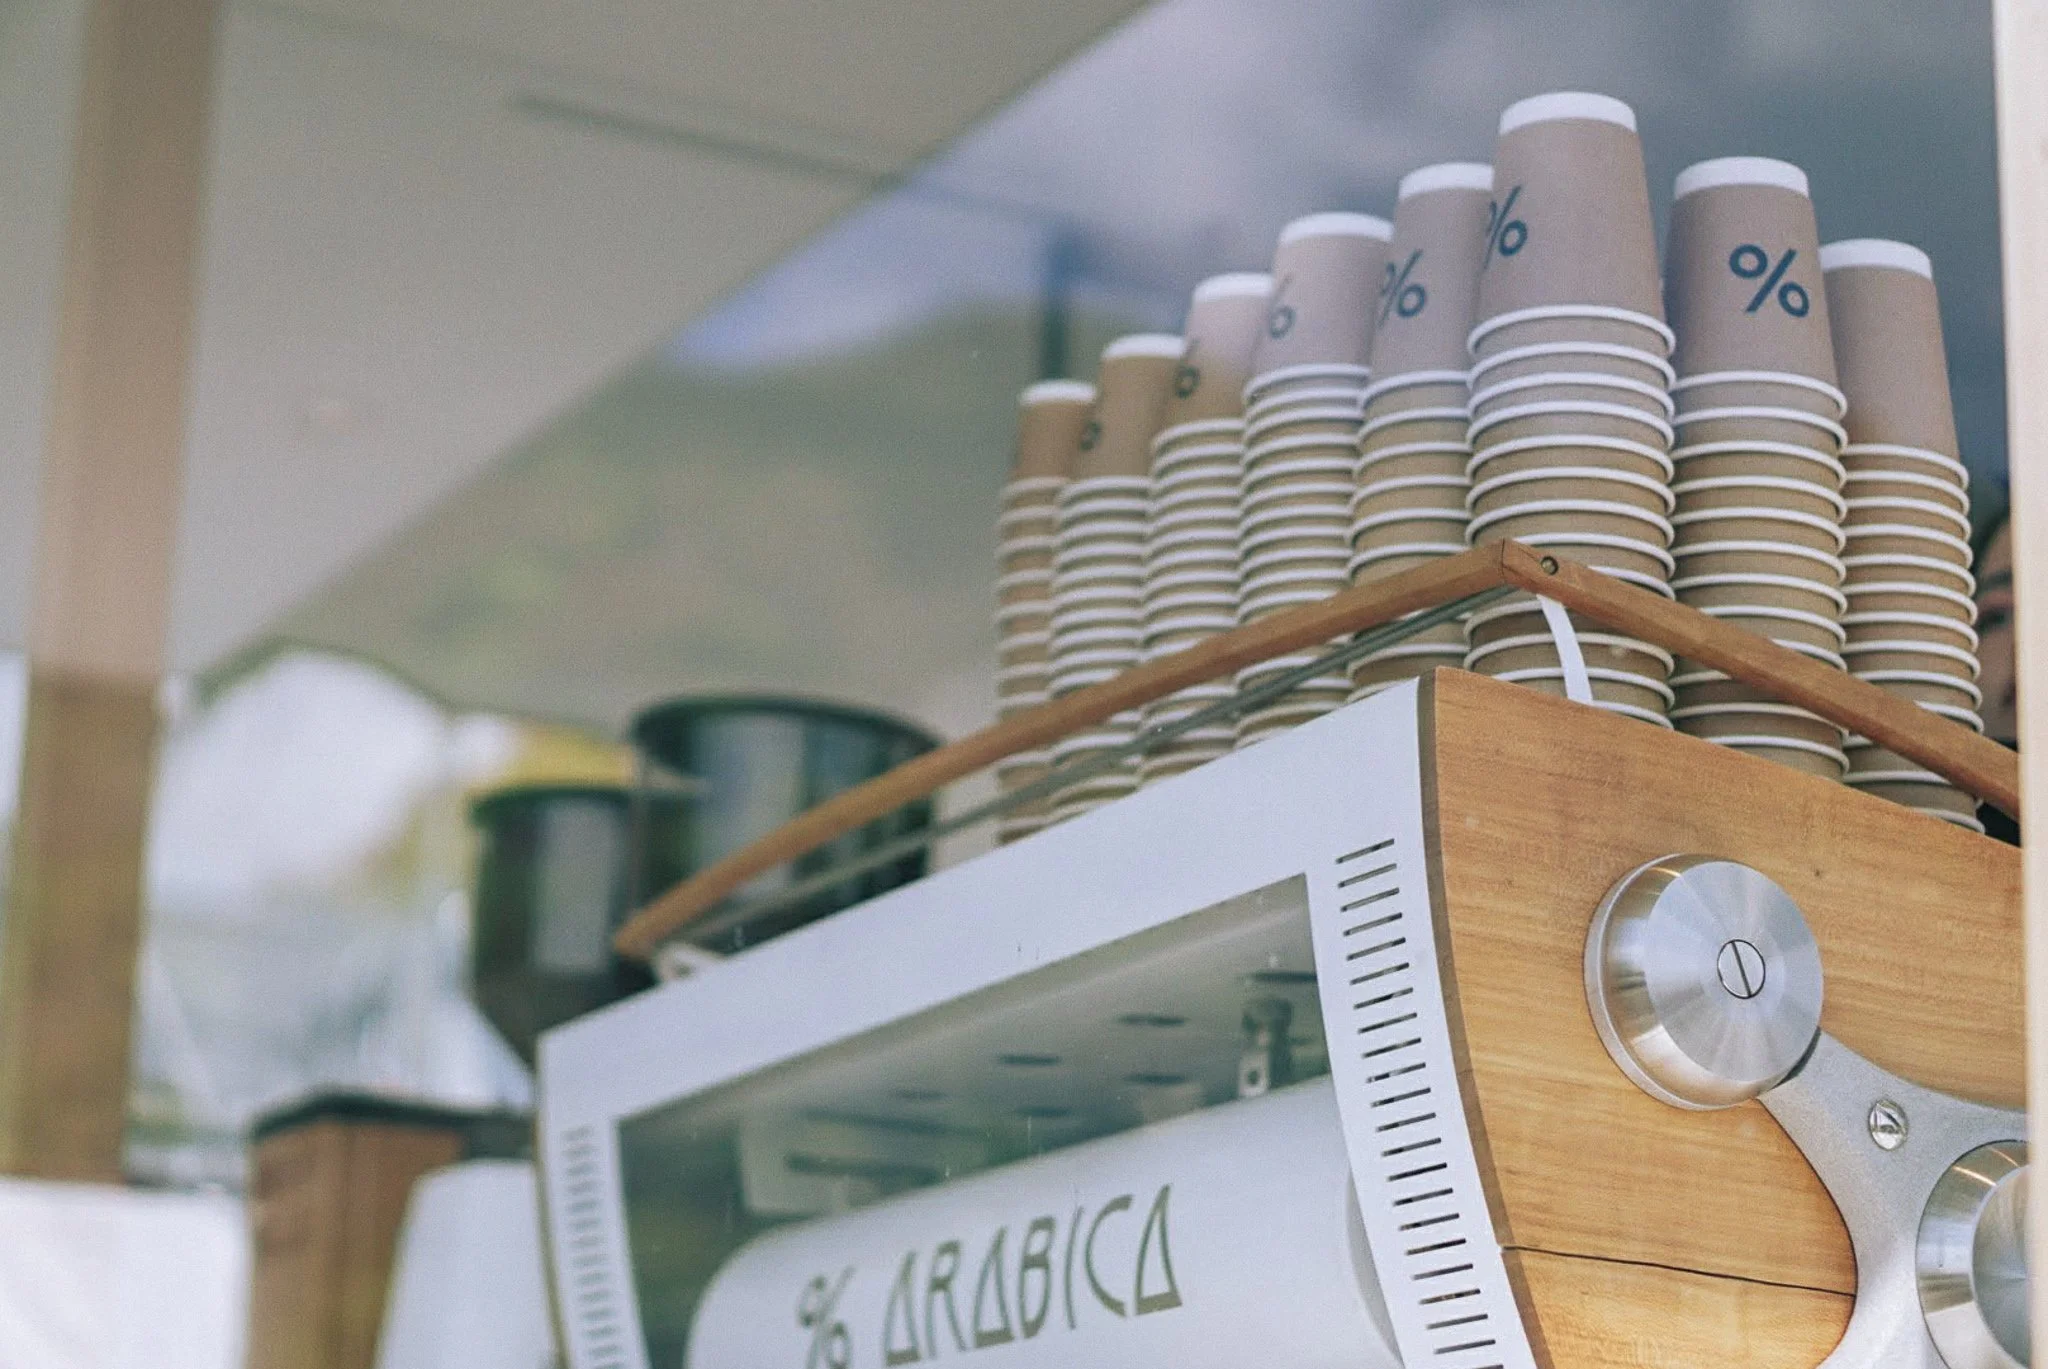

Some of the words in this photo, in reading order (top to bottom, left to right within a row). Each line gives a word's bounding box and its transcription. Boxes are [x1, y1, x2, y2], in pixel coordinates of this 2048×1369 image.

[1728, 243, 1811, 319] %
[796, 1266, 856, 1369] %
[884, 1183, 1183, 1367] ARABICA
